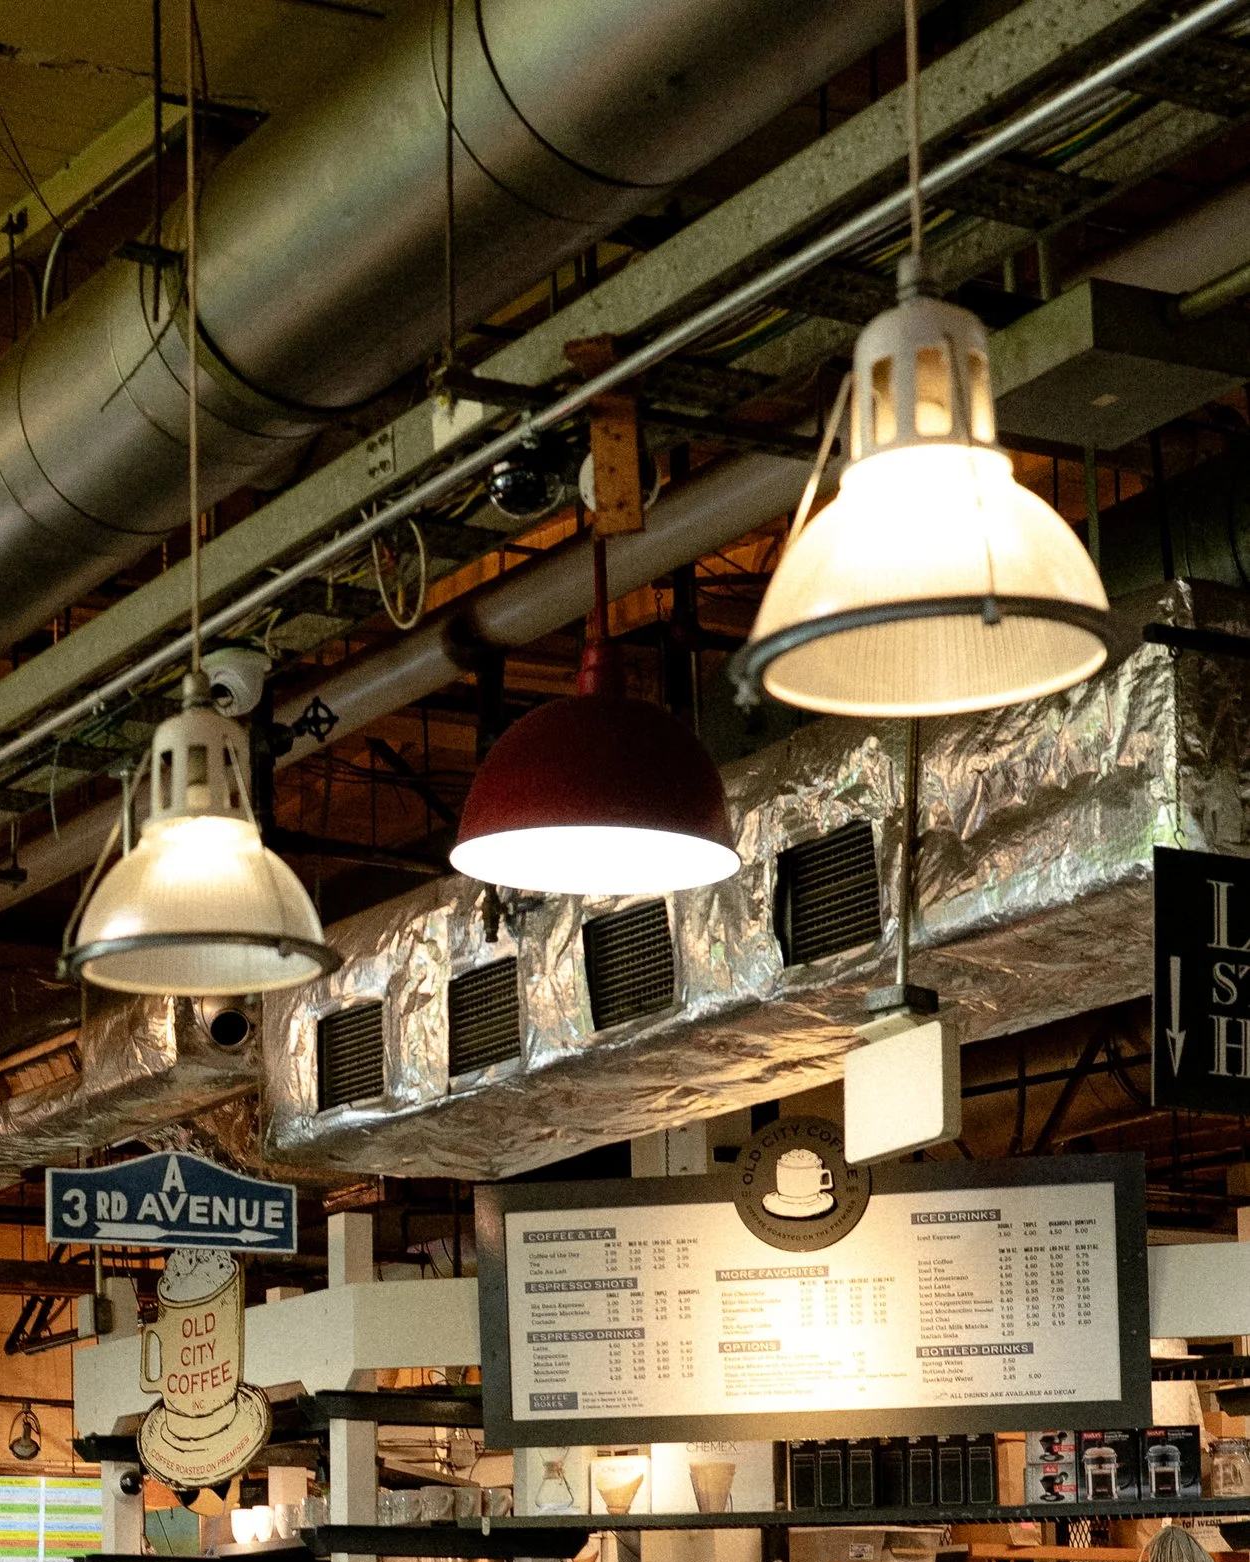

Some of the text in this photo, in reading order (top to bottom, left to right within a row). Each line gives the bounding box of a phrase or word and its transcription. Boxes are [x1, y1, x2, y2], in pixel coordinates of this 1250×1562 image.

[1206, 879, 1250, 951] L
[742, 1124, 858, 1185] OLD CITY COFE
[161, 1154, 187, 1192] A
[137, 1191, 285, 1229] AVENUE
[916, 1211, 995, 1222] ICED DRINKS
[528, 1230, 611, 1241] COFFEE & TEA
[767, 1227, 802, 1240] ROASTED
[815, 1230, 829, 1238] THE
[720, 1267, 824, 1279] MORE FAVORITES
[530, 1280, 633, 1291] ESPRESSO SHOTS
[181, 1312, 216, 1339] OLD
[532, 1330, 640, 1341] ESPRESSO DRINKS
[723, 1342, 776, 1351] OPTIONS
[921, 1345, 1028, 1356] BOTTLED DRINKS
[180, 1340, 217, 1367] CITY
[166, 1361, 233, 1395] COFFEE
[686, 1440, 737, 1453] CHEMEX
[151, 1435, 250, 1475] COFFEE ROASTED ON PREMISES
[1198, 1519, 1222, 1528] wrap
